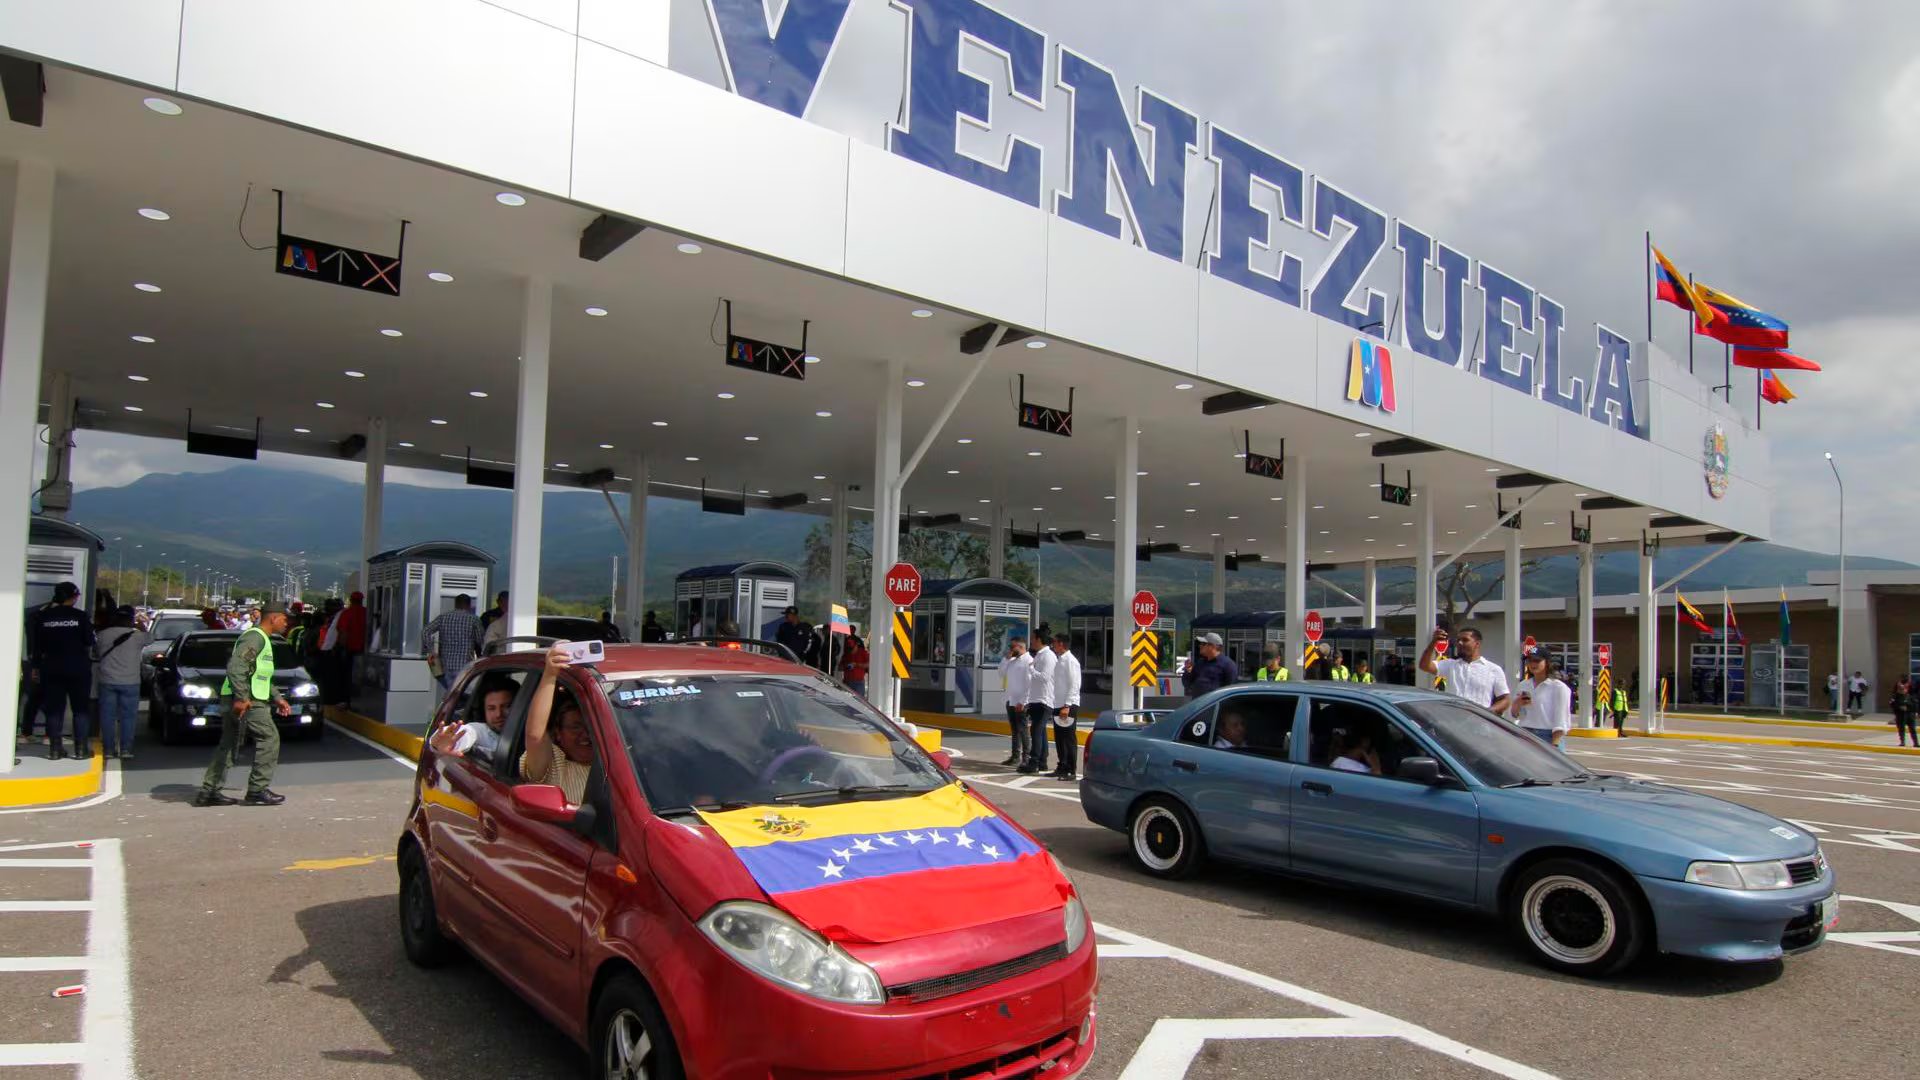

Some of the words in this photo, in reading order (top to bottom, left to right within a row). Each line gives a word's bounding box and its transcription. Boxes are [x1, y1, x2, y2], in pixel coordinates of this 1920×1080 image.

[889, 578, 916, 591] PARE
[1135, 603, 1154, 615] PARE
[1306, 621, 1320, 631] PARE
[619, 685, 702, 701] BERNAL
